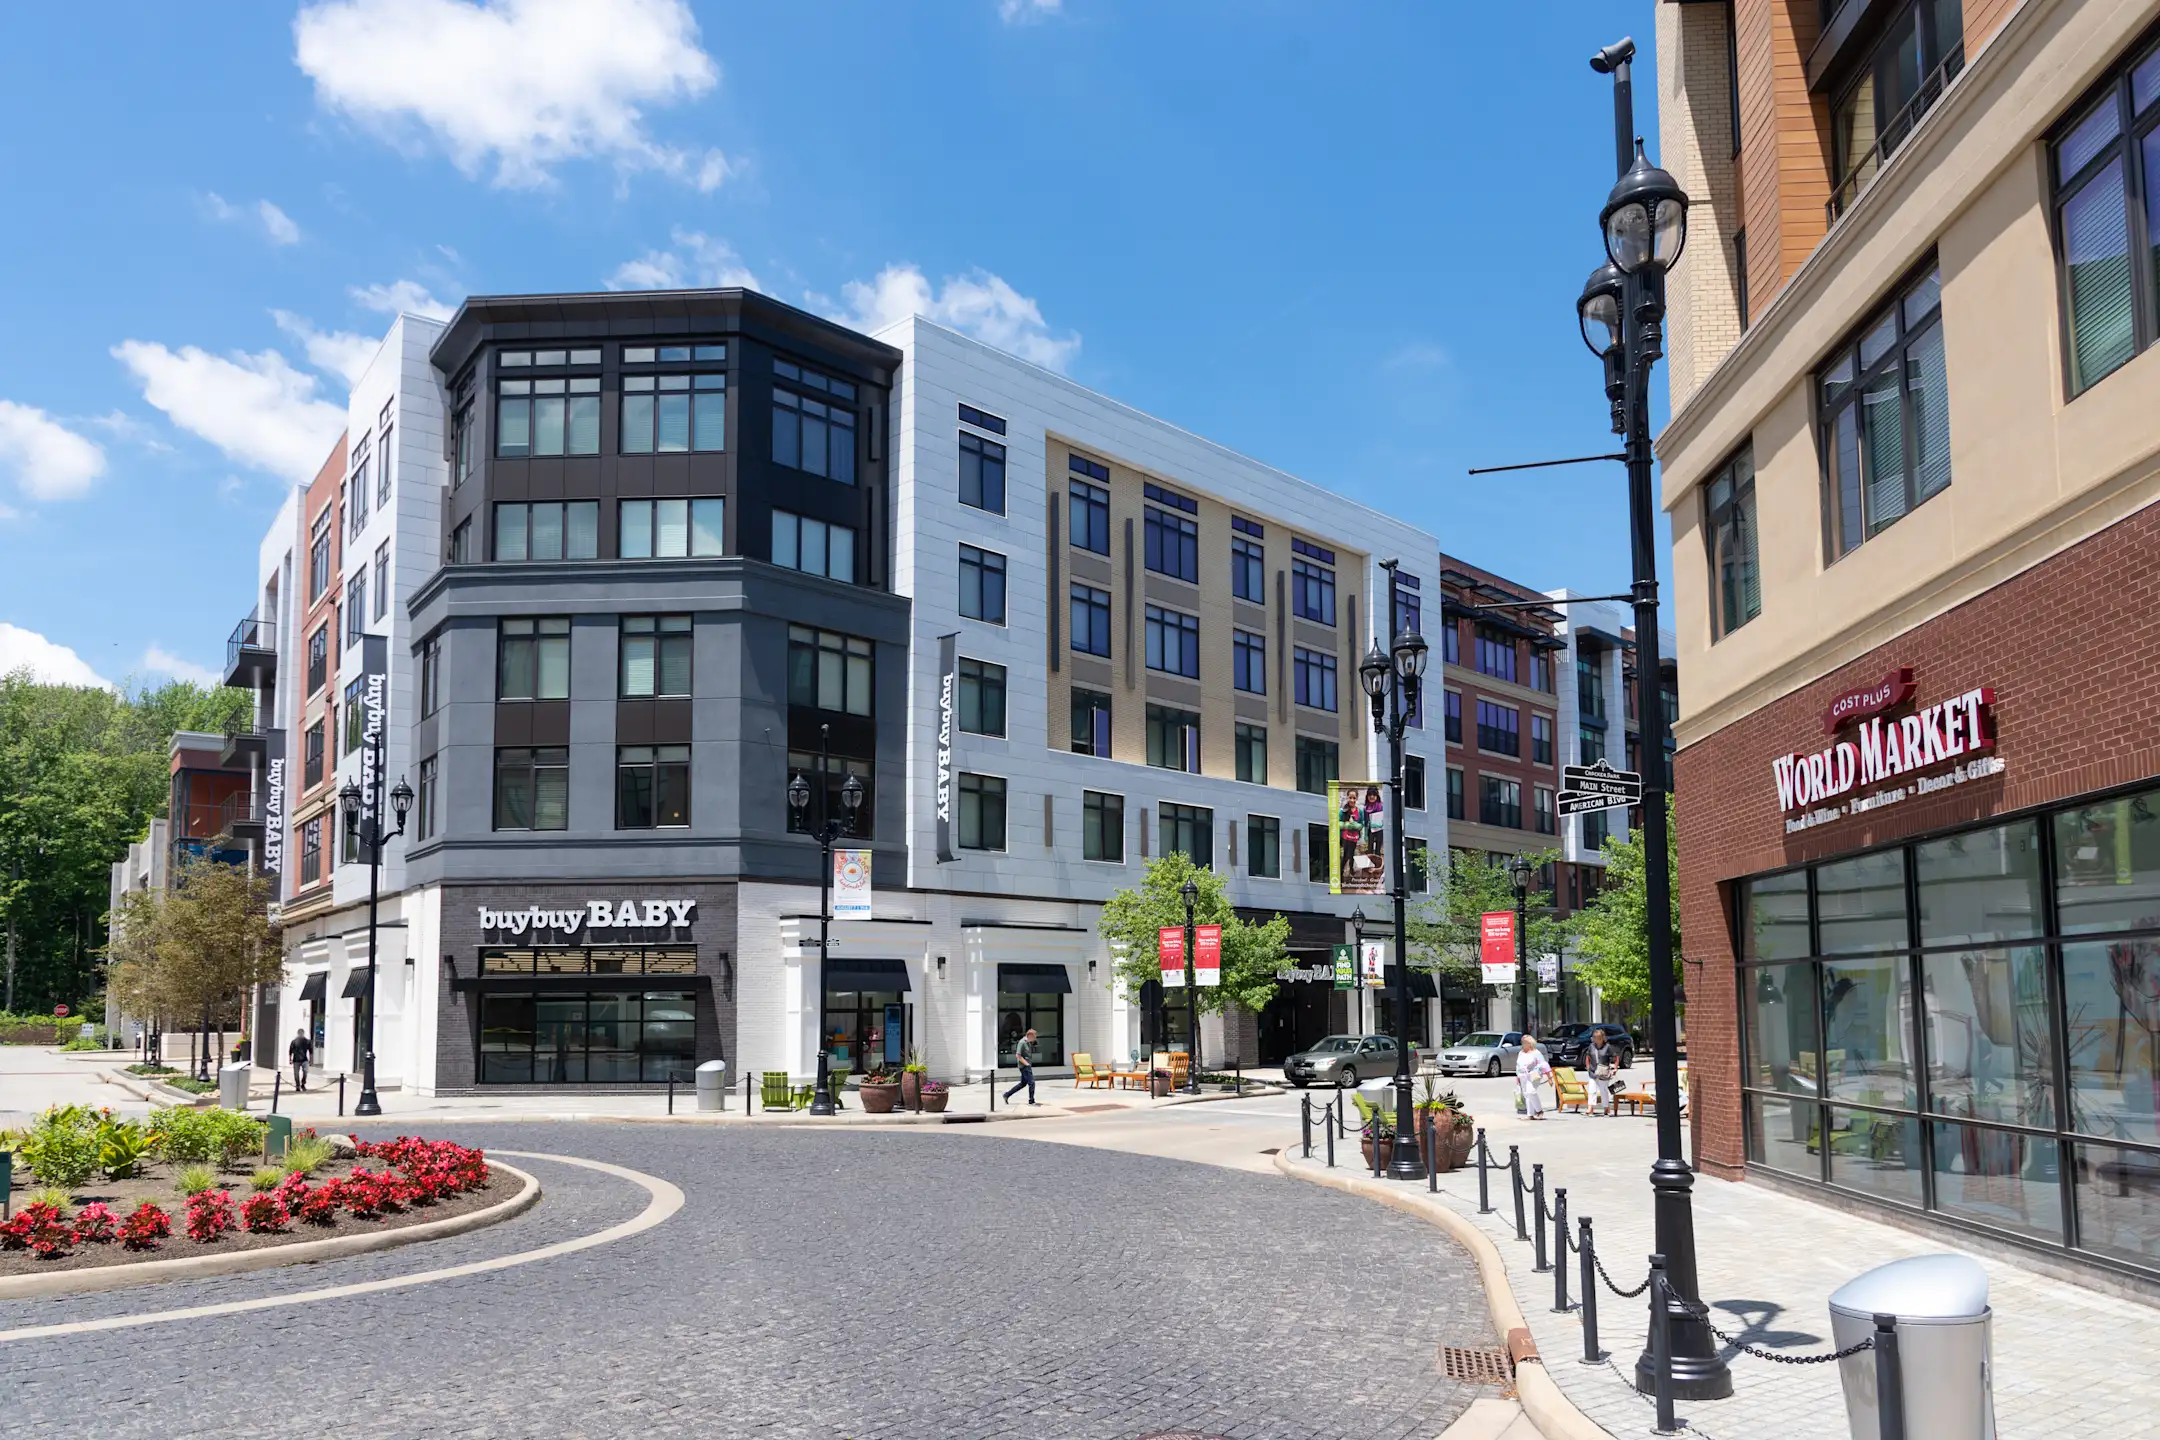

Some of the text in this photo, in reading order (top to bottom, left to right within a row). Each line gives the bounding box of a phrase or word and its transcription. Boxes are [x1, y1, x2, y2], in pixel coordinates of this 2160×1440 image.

[1833, 684, 1891, 716] COST PLUS
[1772, 687, 1984, 812] WORLD MARKET
[1580, 780, 1626, 794] MAIN Street
[1785, 814, 1808, 834] Food
[1814, 808, 1841, 825] Wine
[1850, 788, 1907, 814] Furniture
[1917, 773, 1955, 795] Decor
[1967, 756, 2005, 779] Gifts
[1569, 798, 1605, 812] AMERICAN
[478, 900, 696, 935] buybuy BABY
